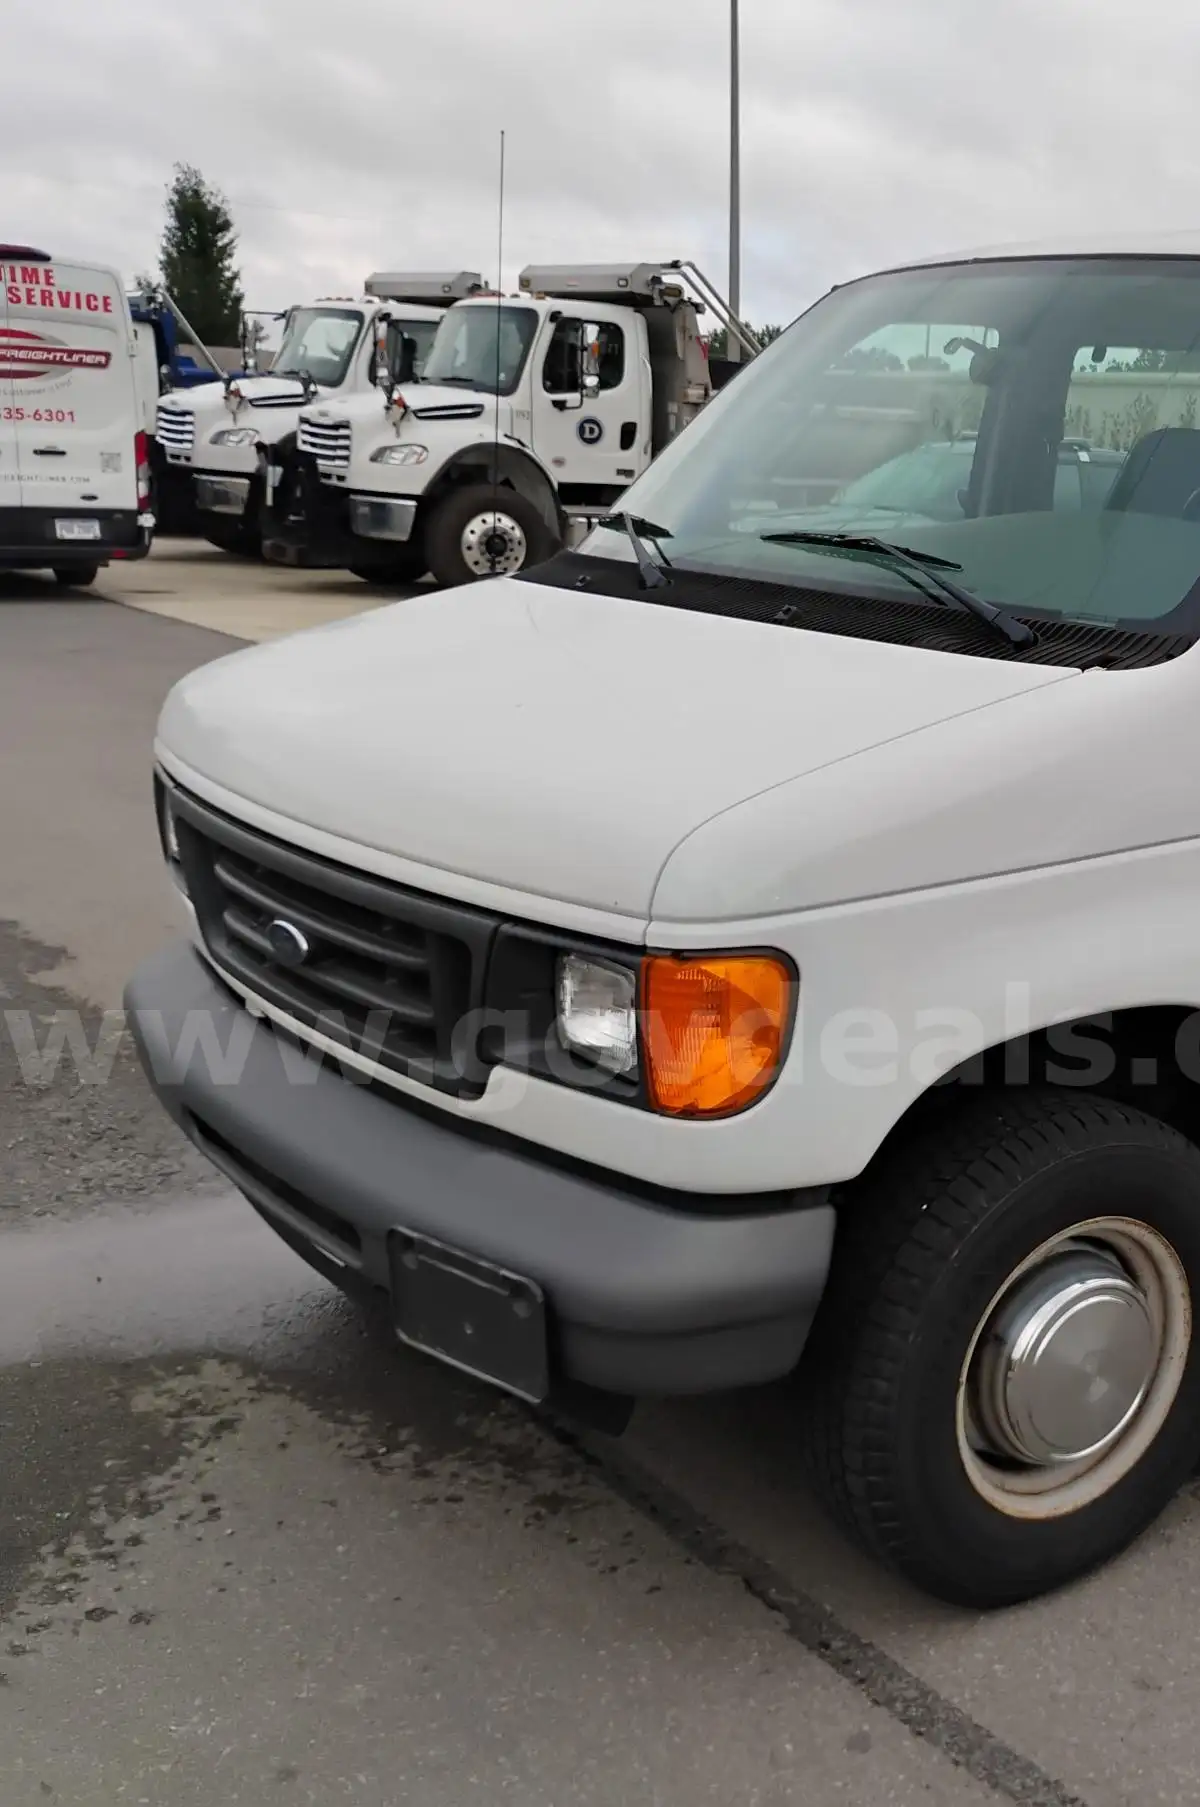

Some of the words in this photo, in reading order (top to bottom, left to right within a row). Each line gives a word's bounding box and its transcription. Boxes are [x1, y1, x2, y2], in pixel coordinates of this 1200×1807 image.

[7, 286, 113, 313] SERVICE
[0, 407, 75, 423] 35-6301
[583, 422, 600, 439] D
